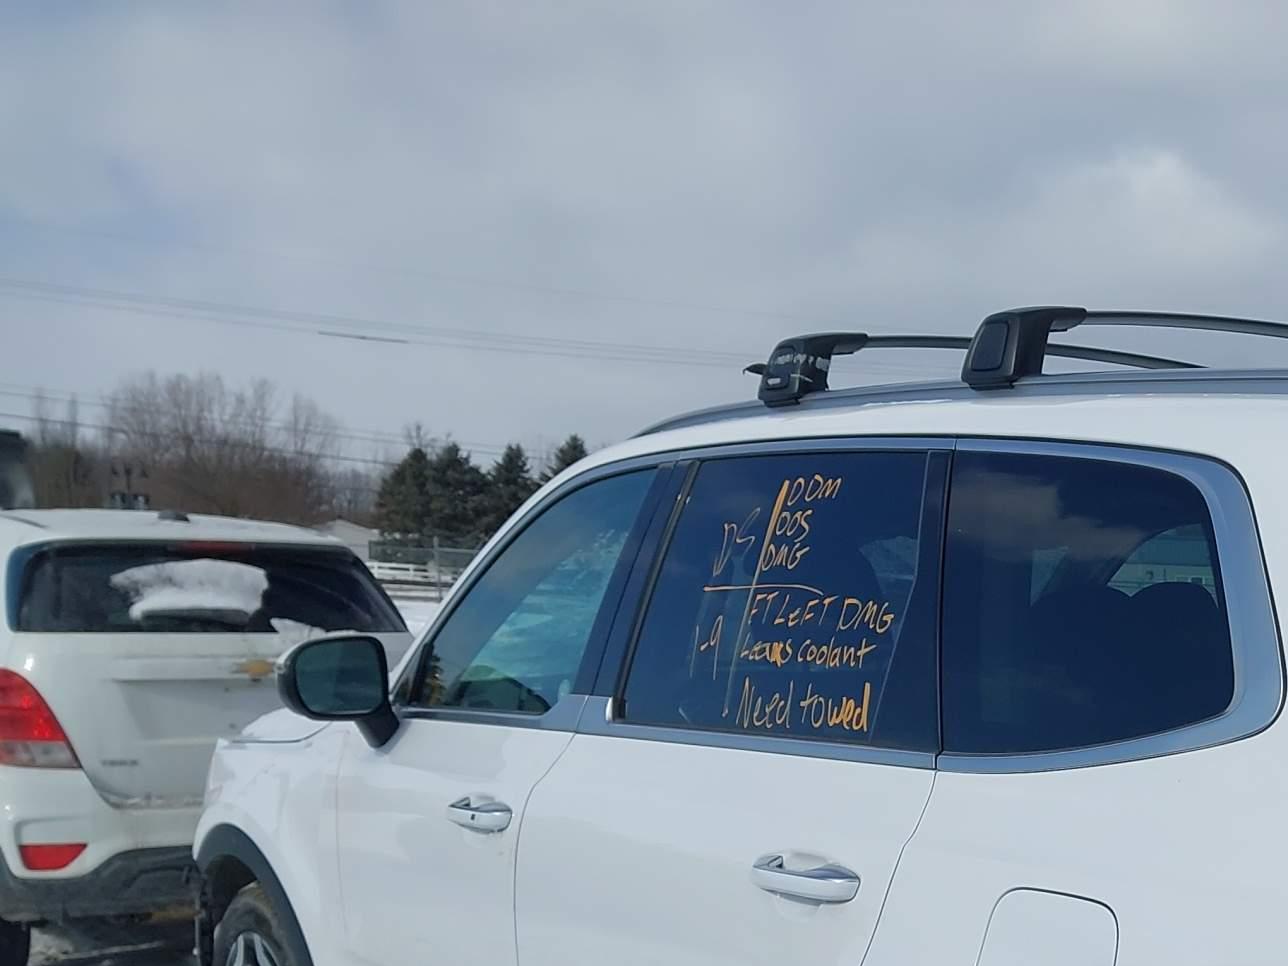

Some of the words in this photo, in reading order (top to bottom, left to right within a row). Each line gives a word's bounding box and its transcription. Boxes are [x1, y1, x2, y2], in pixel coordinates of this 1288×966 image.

[761, 542, 811, 571] DMG
[836, 597, 896, 634] DMG
[797, 637, 877, 669] coolant
[735, 676, 795, 729] Need
[799, 681, 872, 733] towed
